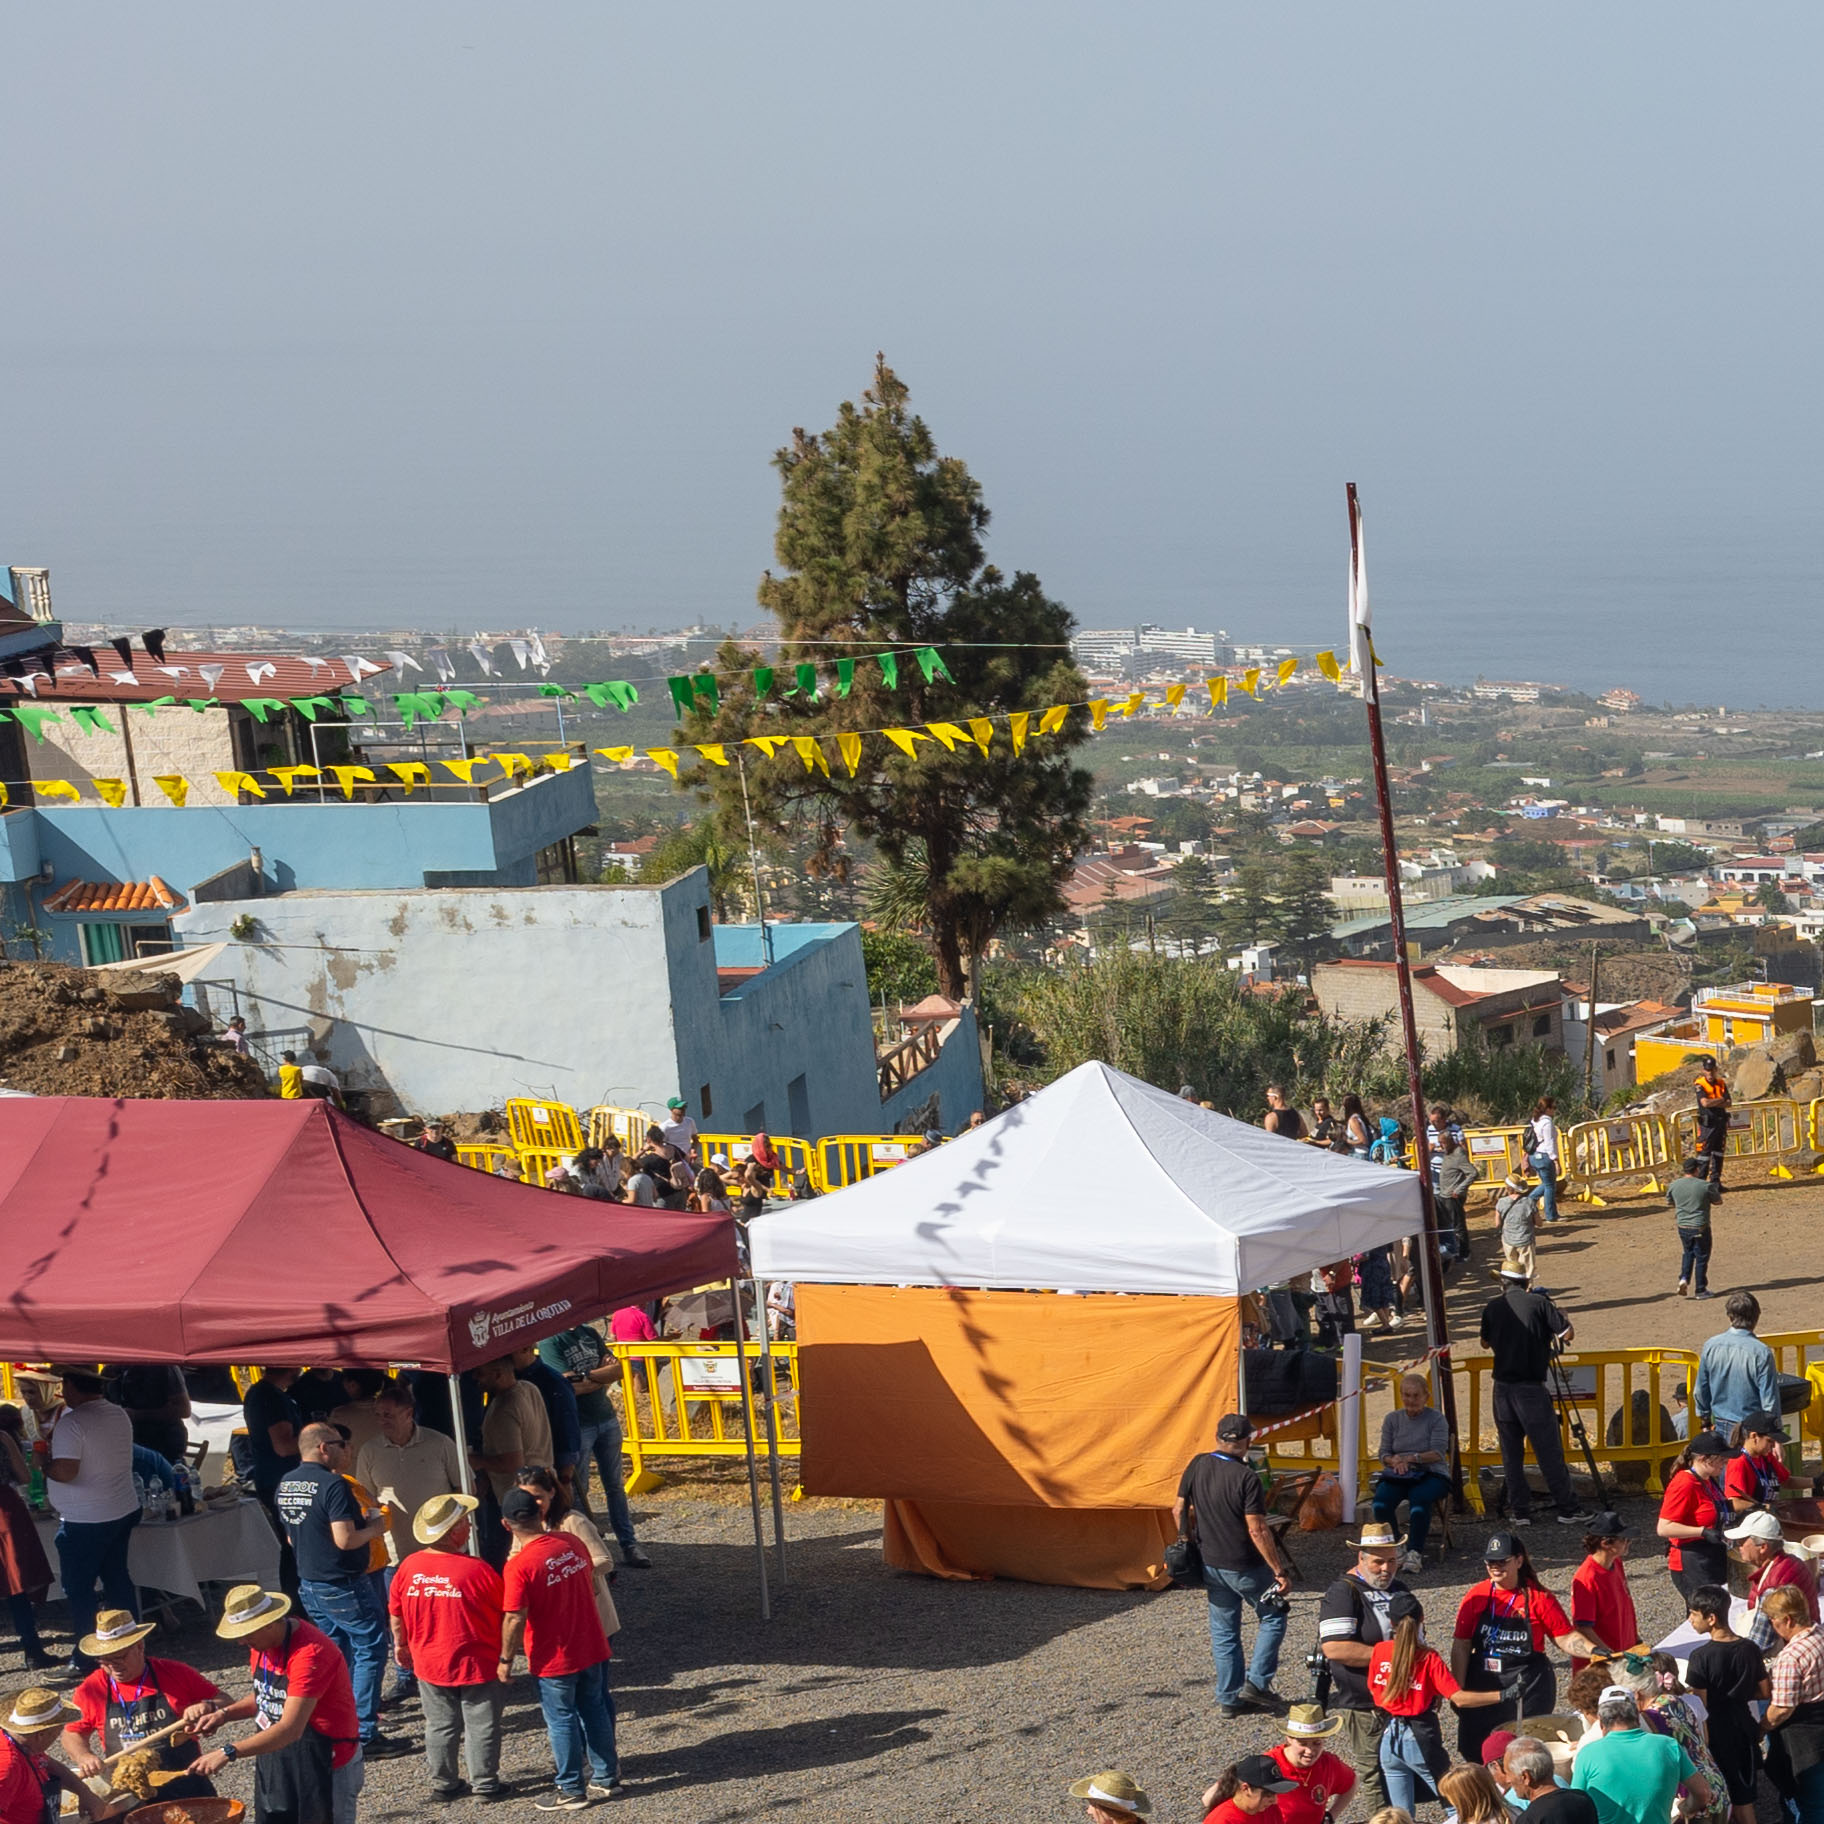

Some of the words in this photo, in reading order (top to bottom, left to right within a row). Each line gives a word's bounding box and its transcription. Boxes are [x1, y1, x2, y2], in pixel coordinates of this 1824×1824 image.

[492, 1319, 515, 1337] VILLA
[515, 1316, 526, 1328] DE
[526, 1312, 537, 1325] LA
[545, 1550, 575, 1570] Fiestas
[412, 1573, 450, 1584] Fiestas
[546, 1573, 562, 1586] La
[561, 1560, 588, 1578] Florida
[407, 1585, 420, 1597] La
